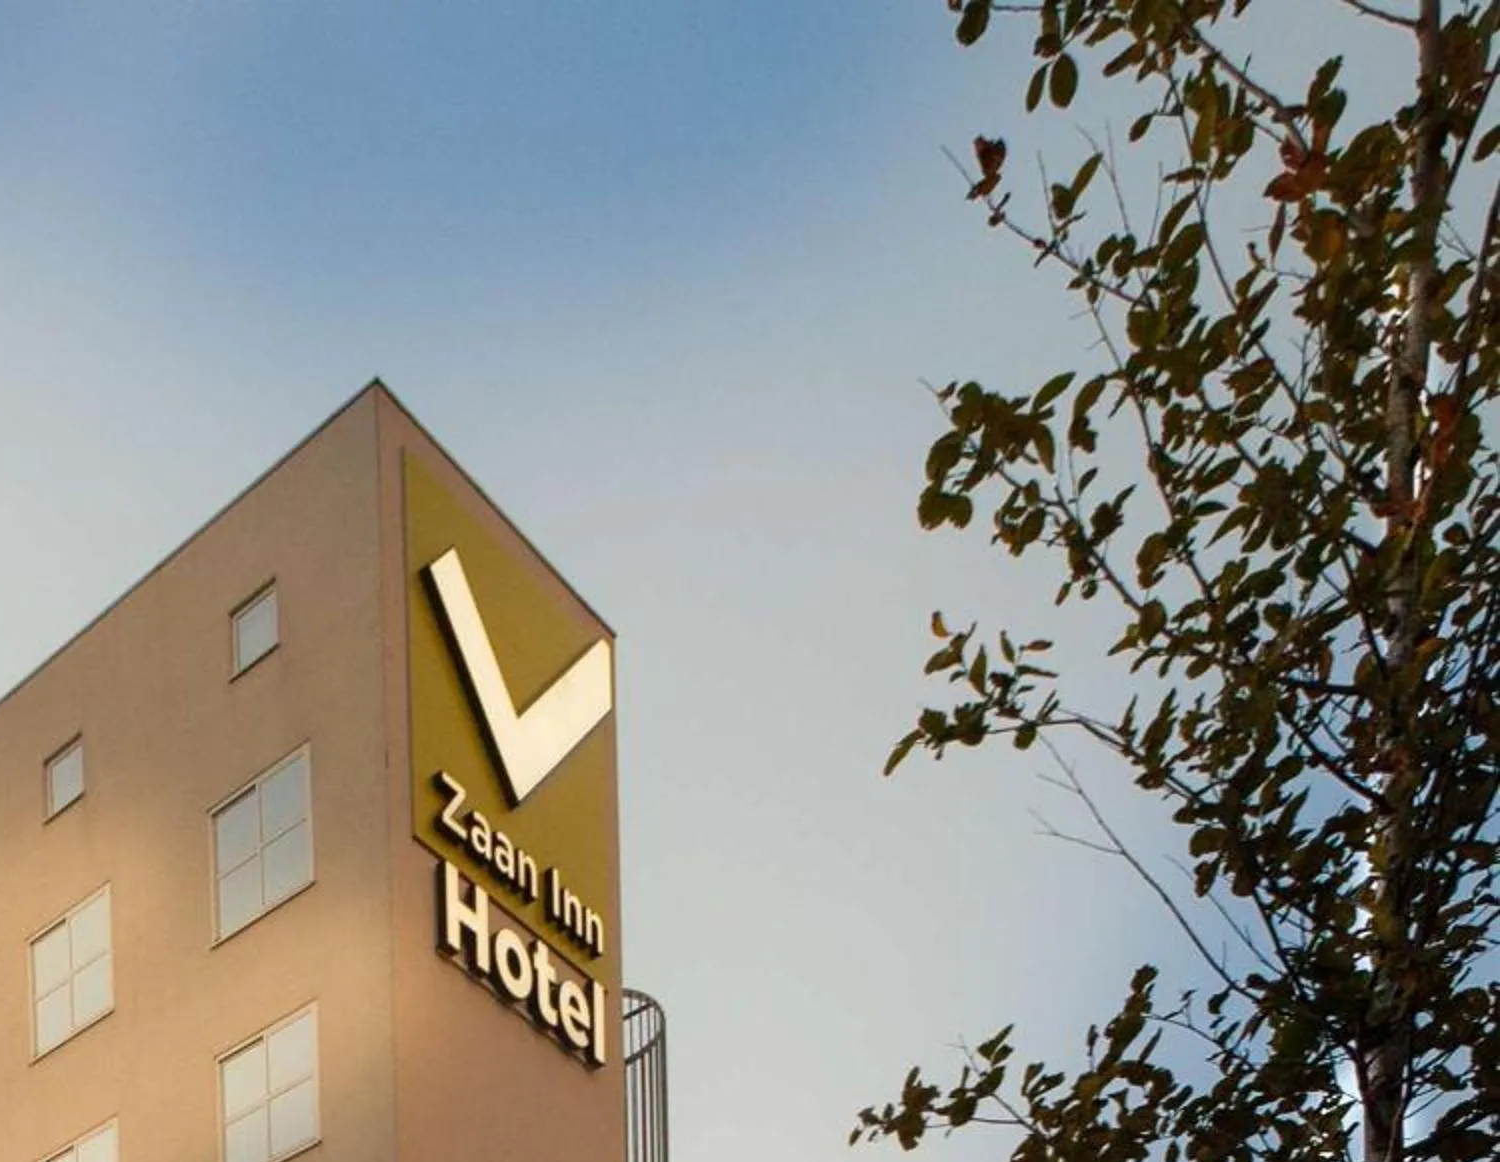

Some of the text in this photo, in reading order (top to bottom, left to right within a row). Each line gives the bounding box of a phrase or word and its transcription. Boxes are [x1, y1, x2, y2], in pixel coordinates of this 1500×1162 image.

[439, 771, 604, 954] Zaan Inn
[444, 860, 606, 1065] Hotel
